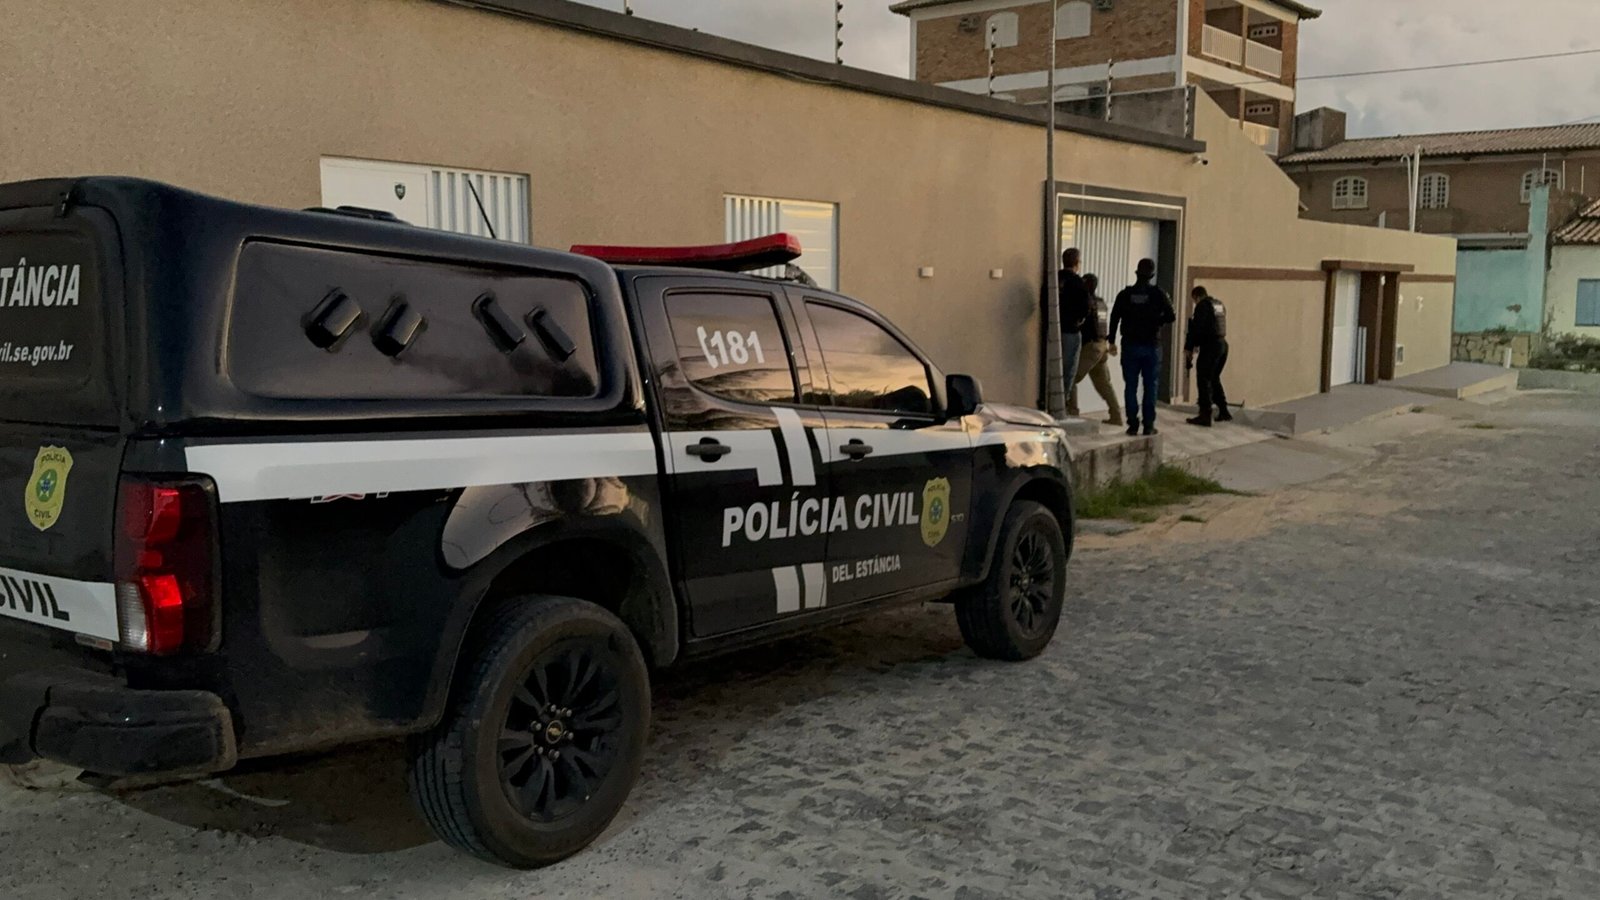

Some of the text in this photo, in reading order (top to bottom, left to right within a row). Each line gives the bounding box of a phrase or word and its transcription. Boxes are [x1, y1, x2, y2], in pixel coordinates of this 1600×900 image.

[0, 257, 81, 307] TÂNCIA
[710, 330, 765, 365] 181
[722, 491, 919, 547] POLÍCIA CIVIL
[832, 564, 854, 583] DEL.
